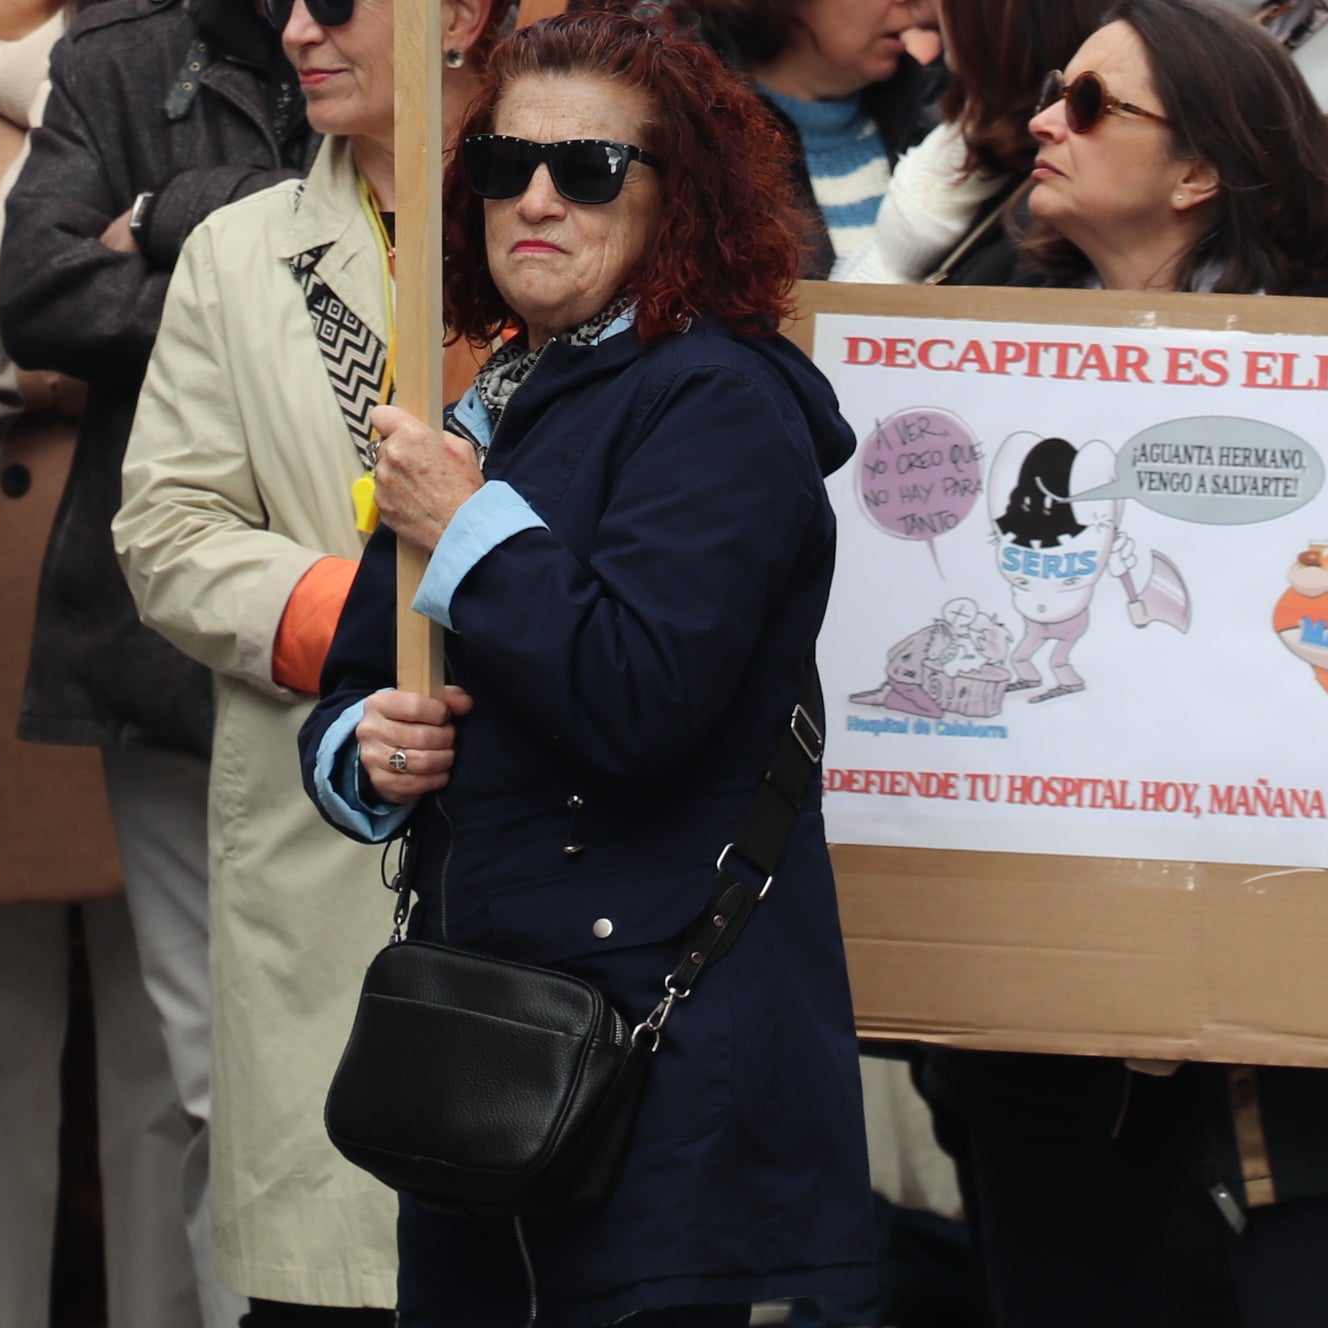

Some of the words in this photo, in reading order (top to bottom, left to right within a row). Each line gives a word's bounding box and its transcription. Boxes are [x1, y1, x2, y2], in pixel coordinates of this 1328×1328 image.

[843, 336, 1154, 384] DECAPITAR
[1162, 347, 1229, 387] ES
[875, 417, 892, 450] A
[864, 459, 888, 480] YO
[896, 449, 944, 475] CREO
[950, 442, 986, 473] QUE
[1132, 443, 1214, 467] ¡AGUANTA
[1218, 446, 1307, 473] HERMANO,
[863, 488, 890, 508] NO
[899, 481, 935, 505] HAY
[942, 476, 984, 498] PARA
[1137, 470, 1193, 493] VENGO
[1196, 473, 1208, 494] A
[1211, 474, 1299, 499] SALVARTE!
[897, 509, 959, 537] TANTO
[1001, 546, 1099, 580] SERIS
[846, 715, 909, 737] Hospital
[912, 719, 931, 735] de
[963, 773, 1002, 803] TU
[1006, 774, 1136, 812] HOSPITAL
[1138, 779, 1202, 819] HOY,
[1207, 777, 1328, 820] MAÑANA
